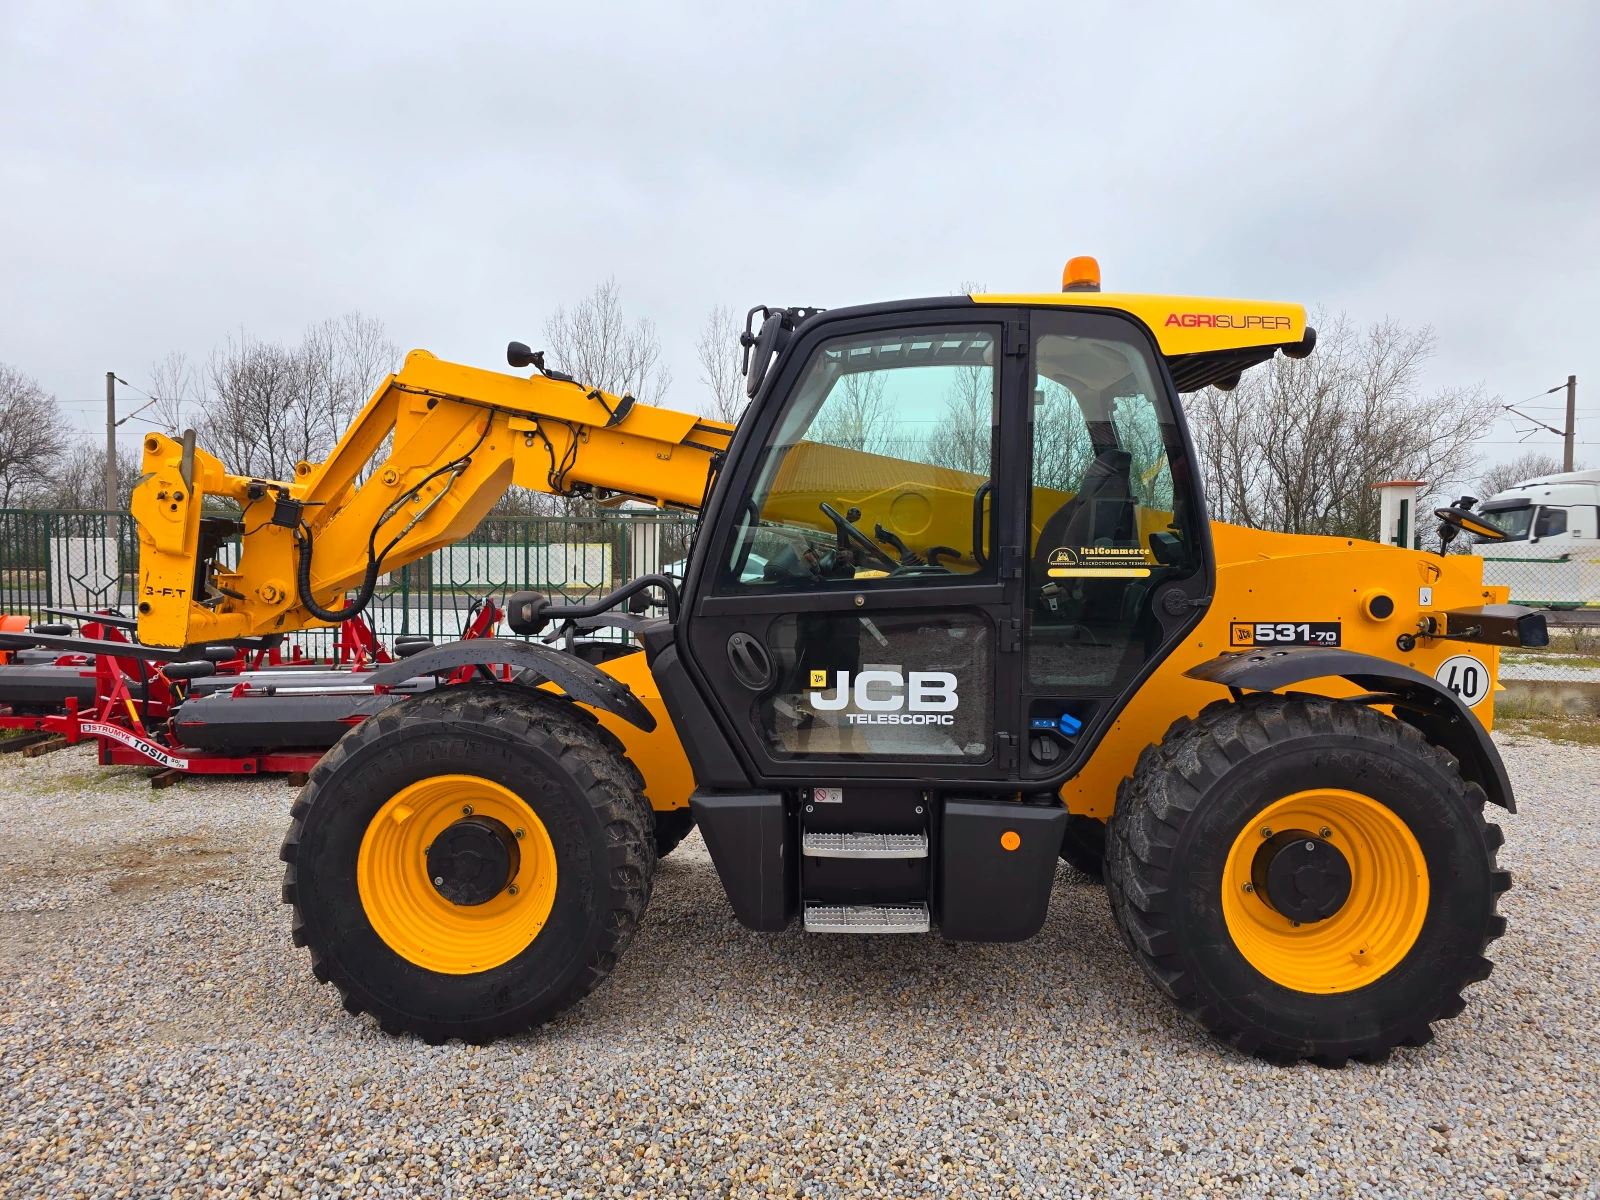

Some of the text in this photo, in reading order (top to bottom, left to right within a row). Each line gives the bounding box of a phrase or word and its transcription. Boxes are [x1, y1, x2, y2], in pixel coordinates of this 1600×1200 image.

[1164, 313, 1291, 330] AGRISUPER
[1080, 547, 1150, 555] ItalCommerce
[1235, 628, 1252, 641] JCB
[1447, 666, 1478, 698] 40
[810, 670, 959, 712] JCB
[846, 714, 954, 725] TELESCOPIC
[91, 724, 132, 741] STRUMYK
[134, 739, 168, 764] TOSIA
